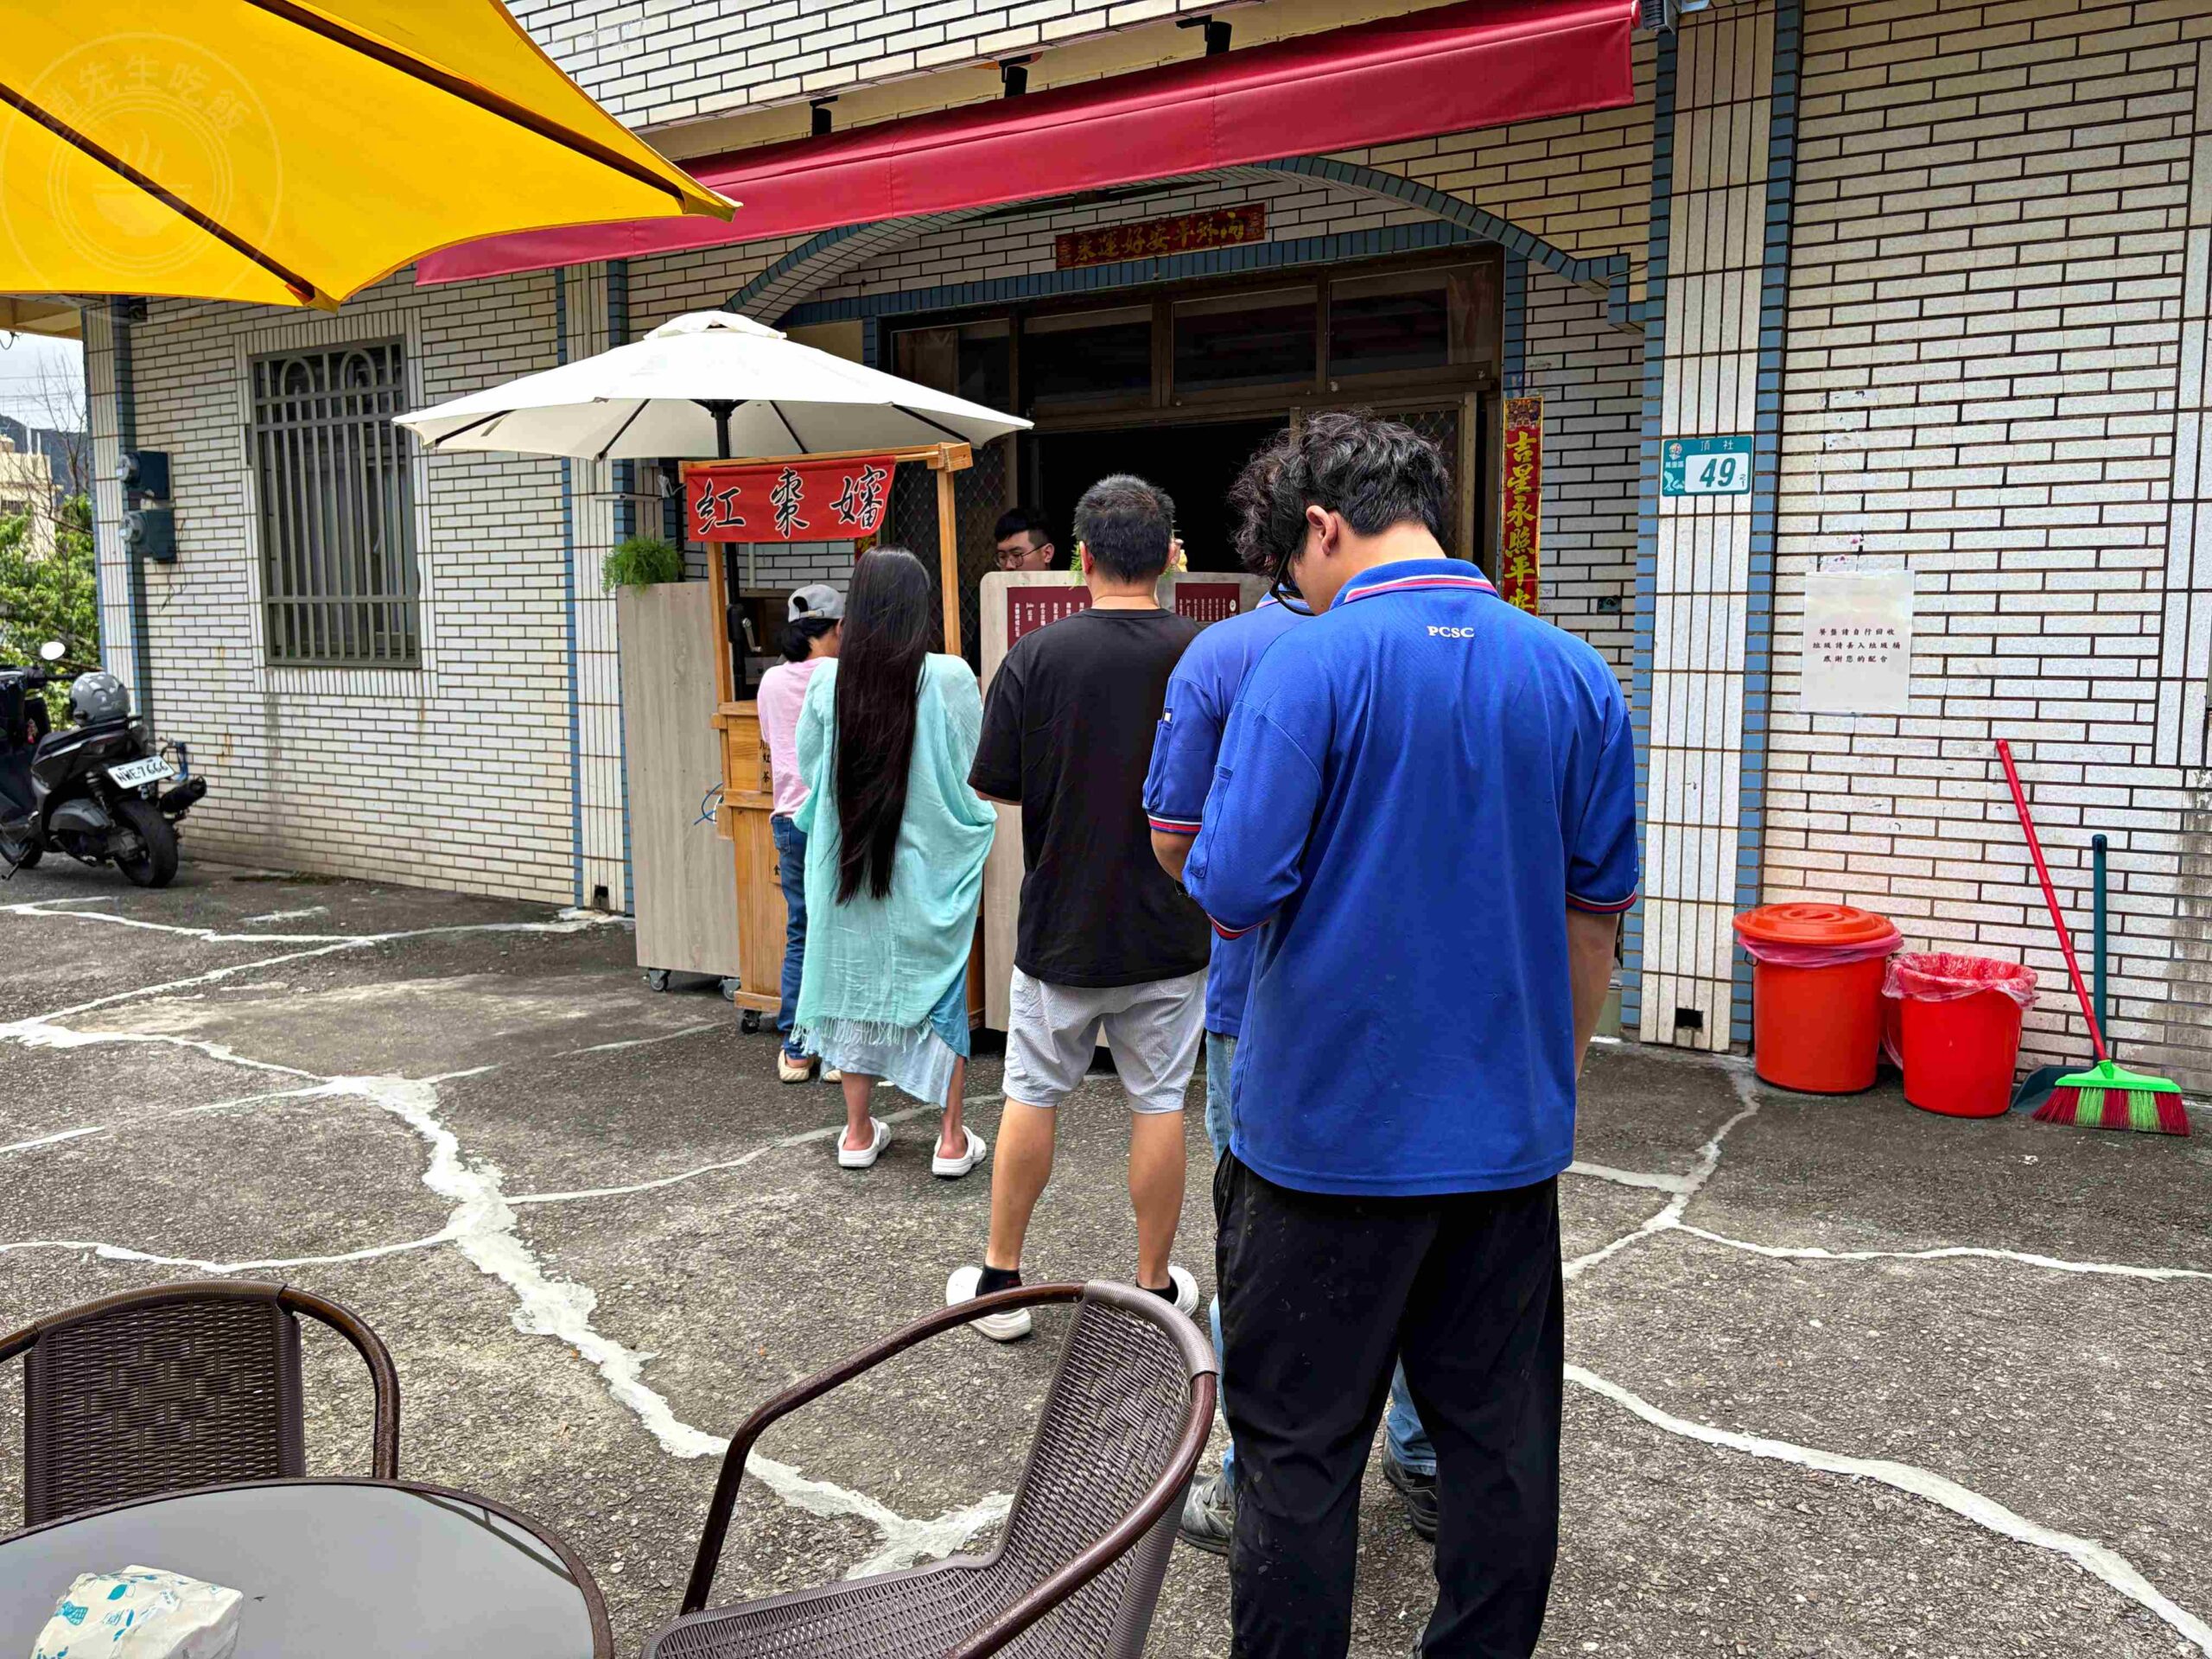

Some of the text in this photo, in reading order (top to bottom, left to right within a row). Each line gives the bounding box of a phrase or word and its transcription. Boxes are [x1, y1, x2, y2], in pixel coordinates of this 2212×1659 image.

[1700, 439, 1734, 452] 頂社
[1700, 457, 1737, 487] 49
[695, 463, 888, 540] 紅棗嬸
[1426, 625, 1475, 639] PCSC
[1822, 654, 1889, 664] 感謝您的配合
